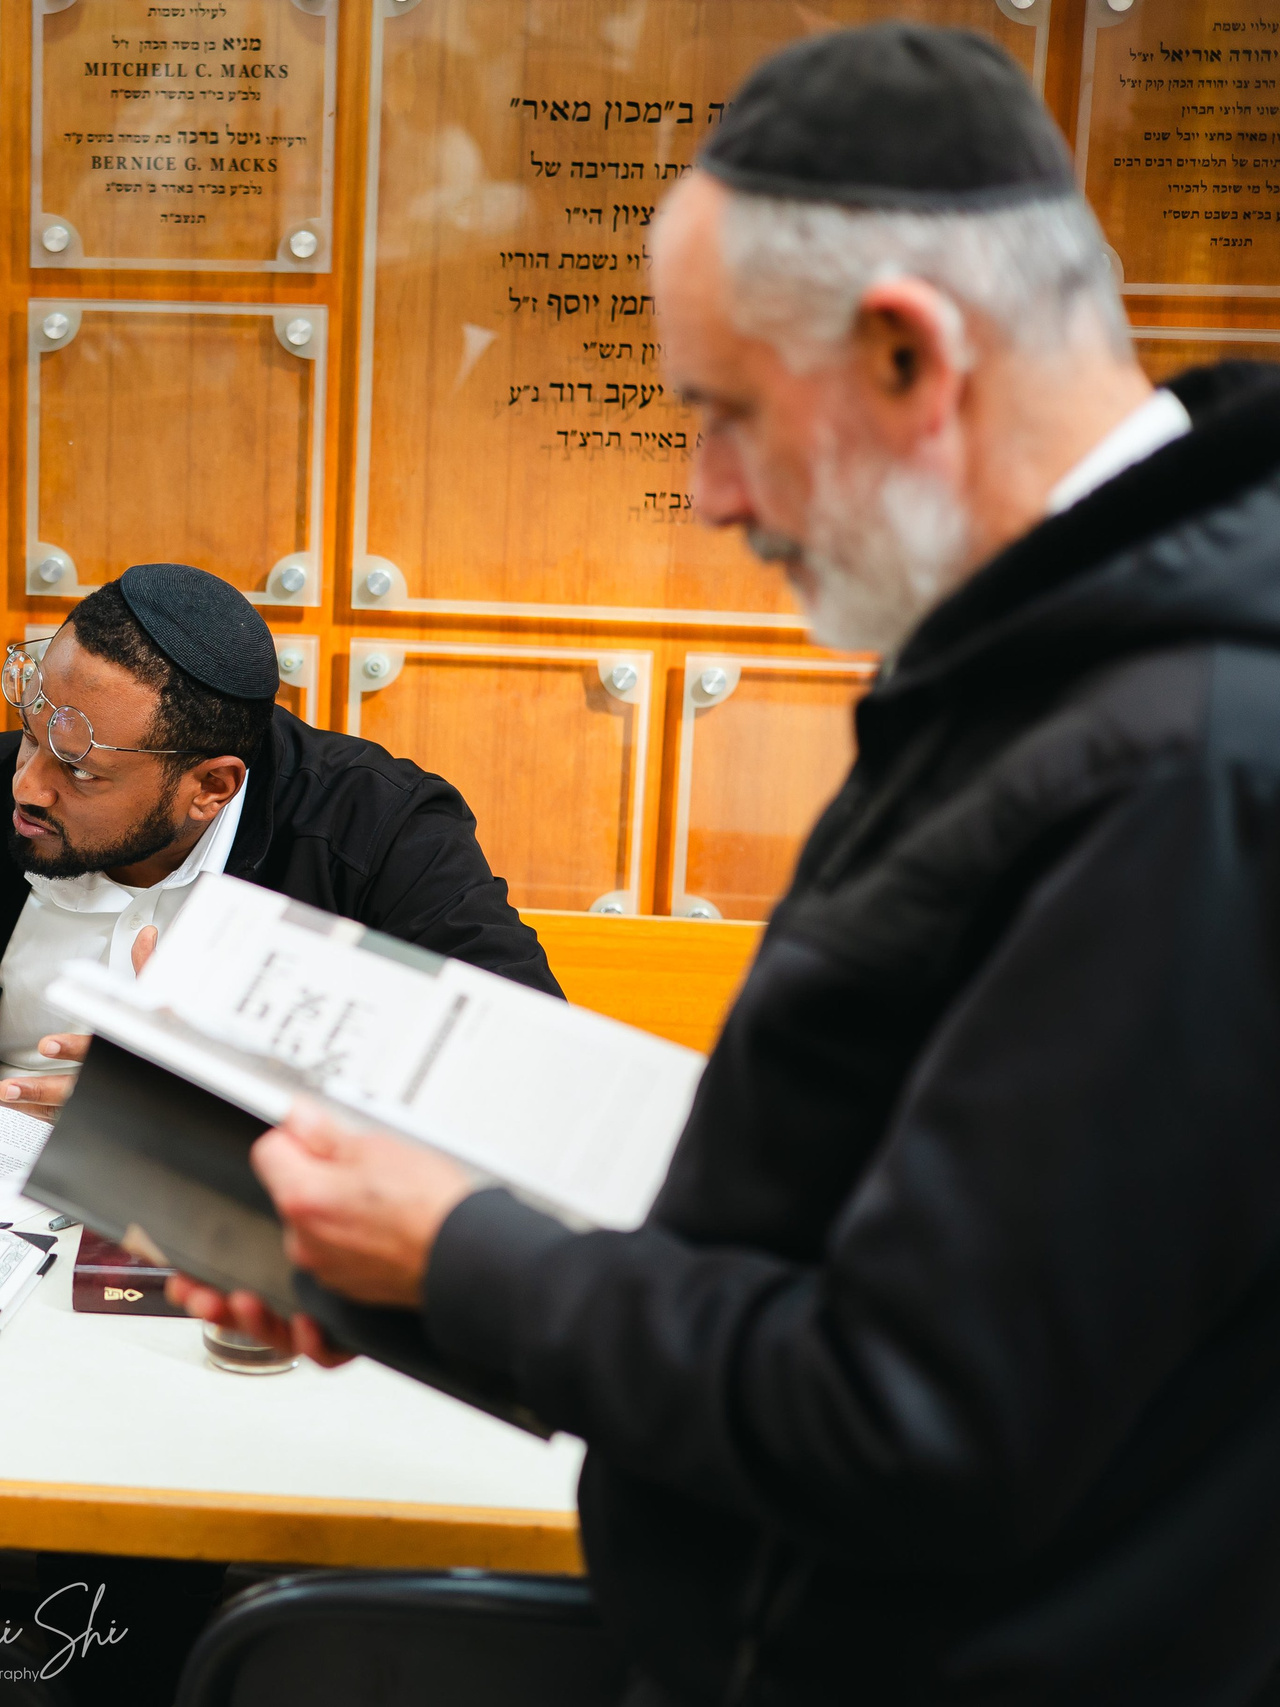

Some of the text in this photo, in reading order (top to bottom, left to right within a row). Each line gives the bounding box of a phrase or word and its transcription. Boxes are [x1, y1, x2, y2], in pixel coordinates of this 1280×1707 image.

[147, 2, 227, 20] לעילוי נשמות
[1212, 17, 1280, 34] עילוי נשמת
[138, 39, 168, 54] הכהן
[171, 40, 200, 51] משה
[203, 40, 216, 54] בן
[222, 37, 262, 52] מניא
[1160, 41, 1222, 63] אוריאל
[1229, 48, 1279, 63] יהודה
[84, 62, 289, 79] MITCHELL C. MACKS
[1145, 78, 1165, 92] קוק
[1168, 78, 1194, 92] הכהן
[1197, 78, 1229, 89] יהודה
[1232, 78, 1250, 89] צבי
[1254, 78, 1276, 89] הרב
[154, 89, 195, 101] בתשרי
[1181, 100, 1280, 118] שוני חלוצי חברון
[176, 130, 220, 145] ברכה
[225, 123, 262, 145] גיטל
[1143, 131, 1171, 142] שנים
[1176, 126, 1200, 142] יובל
[1236, 131, 1268, 142] מאיר
[91, 155, 278, 173] BERNICE G. MACKS
[530, 150, 694, 180] מתו הנדיבה של
[1113, 153, 1280, 168] תיהם של תלמידים רבים רבים
[161, 184, 193, 194] באדר
[1167, 179, 1208, 193] להכירו
[1212, 184, 1243, 194] שזכה
[1247, 184, 1261, 194] מי
[1204, 210, 1238, 220] בשבט
[499, 244, 655, 271] לוי נשמת הוריו
[546, 292, 600, 321] יוסף
[610, 293, 658, 322] חמן
[641, 342, 664, 365] יון
[549, 382, 593, 403] דוד
[603, 382, 665, 410] יעקב
[629, 430, 688, 449] באייר
[644, 491, 695, 510] צב"ה
